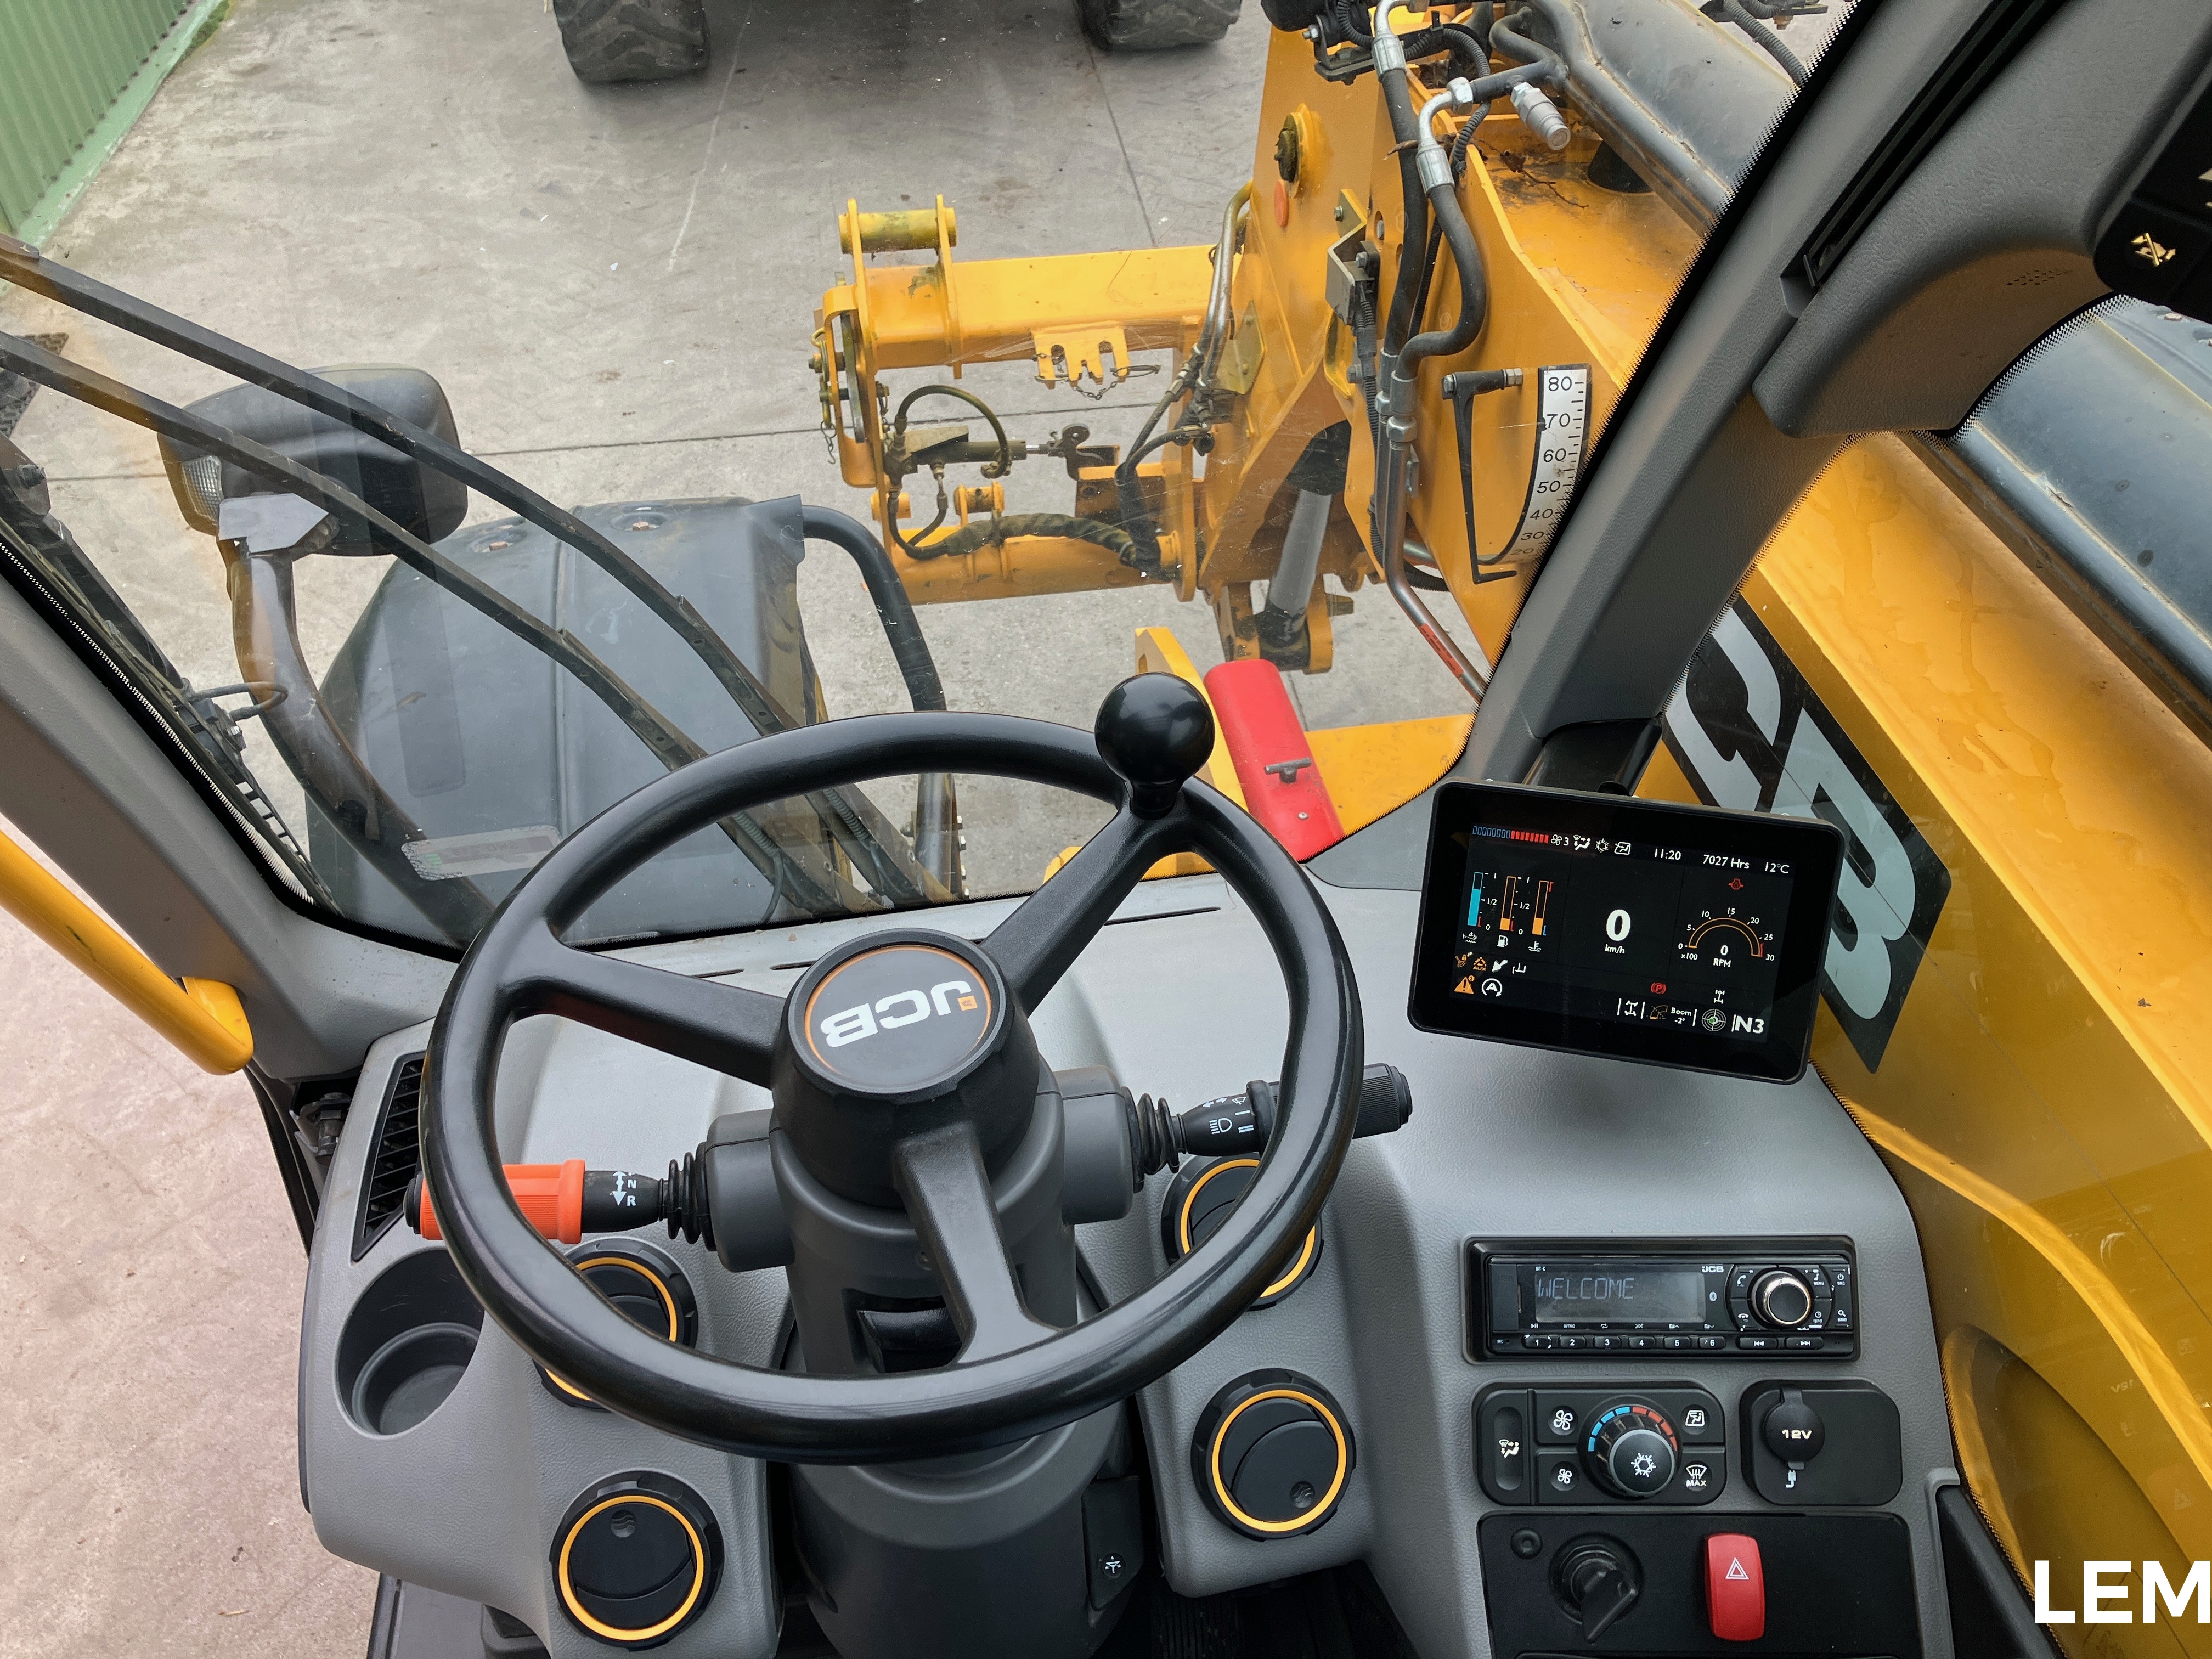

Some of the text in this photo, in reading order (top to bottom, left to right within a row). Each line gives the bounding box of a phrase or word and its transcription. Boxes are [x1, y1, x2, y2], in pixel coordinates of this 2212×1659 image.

[1548, 376, 1572, 392] 80
[1547, 413, 1571, 428] 70
[1543, 448, 1567, 462] 60
[1537, 480, 1561, 494] 50
[1530, 509, 1553, 520] 40
[1521, 531, 1544, 540] 30
[1563, 837, 1570, 846] 3
[1654, 848, 1681, 860] 11:20
[1703, 854, 1750, 869] 7027 Hrs
[1764, 862, 1790, 874] 12°C
[1606, 909, 1631, 941] 0
[1605, 944, 1625, 954] km/h
[1720, 945, 1729, 956] 0
[1713, 957, 1731, 968] RPM
[821, 980, 978, 1047] JCB
[1671, 1007, 1692, 1017] Boom
[1735, 1015, 1764, 1034] N3
[627, 1180, 636, 1189] N
[627, 1195, 636, 1206] R
[1538, 1277, 1635, 1300] WELCOME
[1782, 1429, 1812, 1439] 12V
